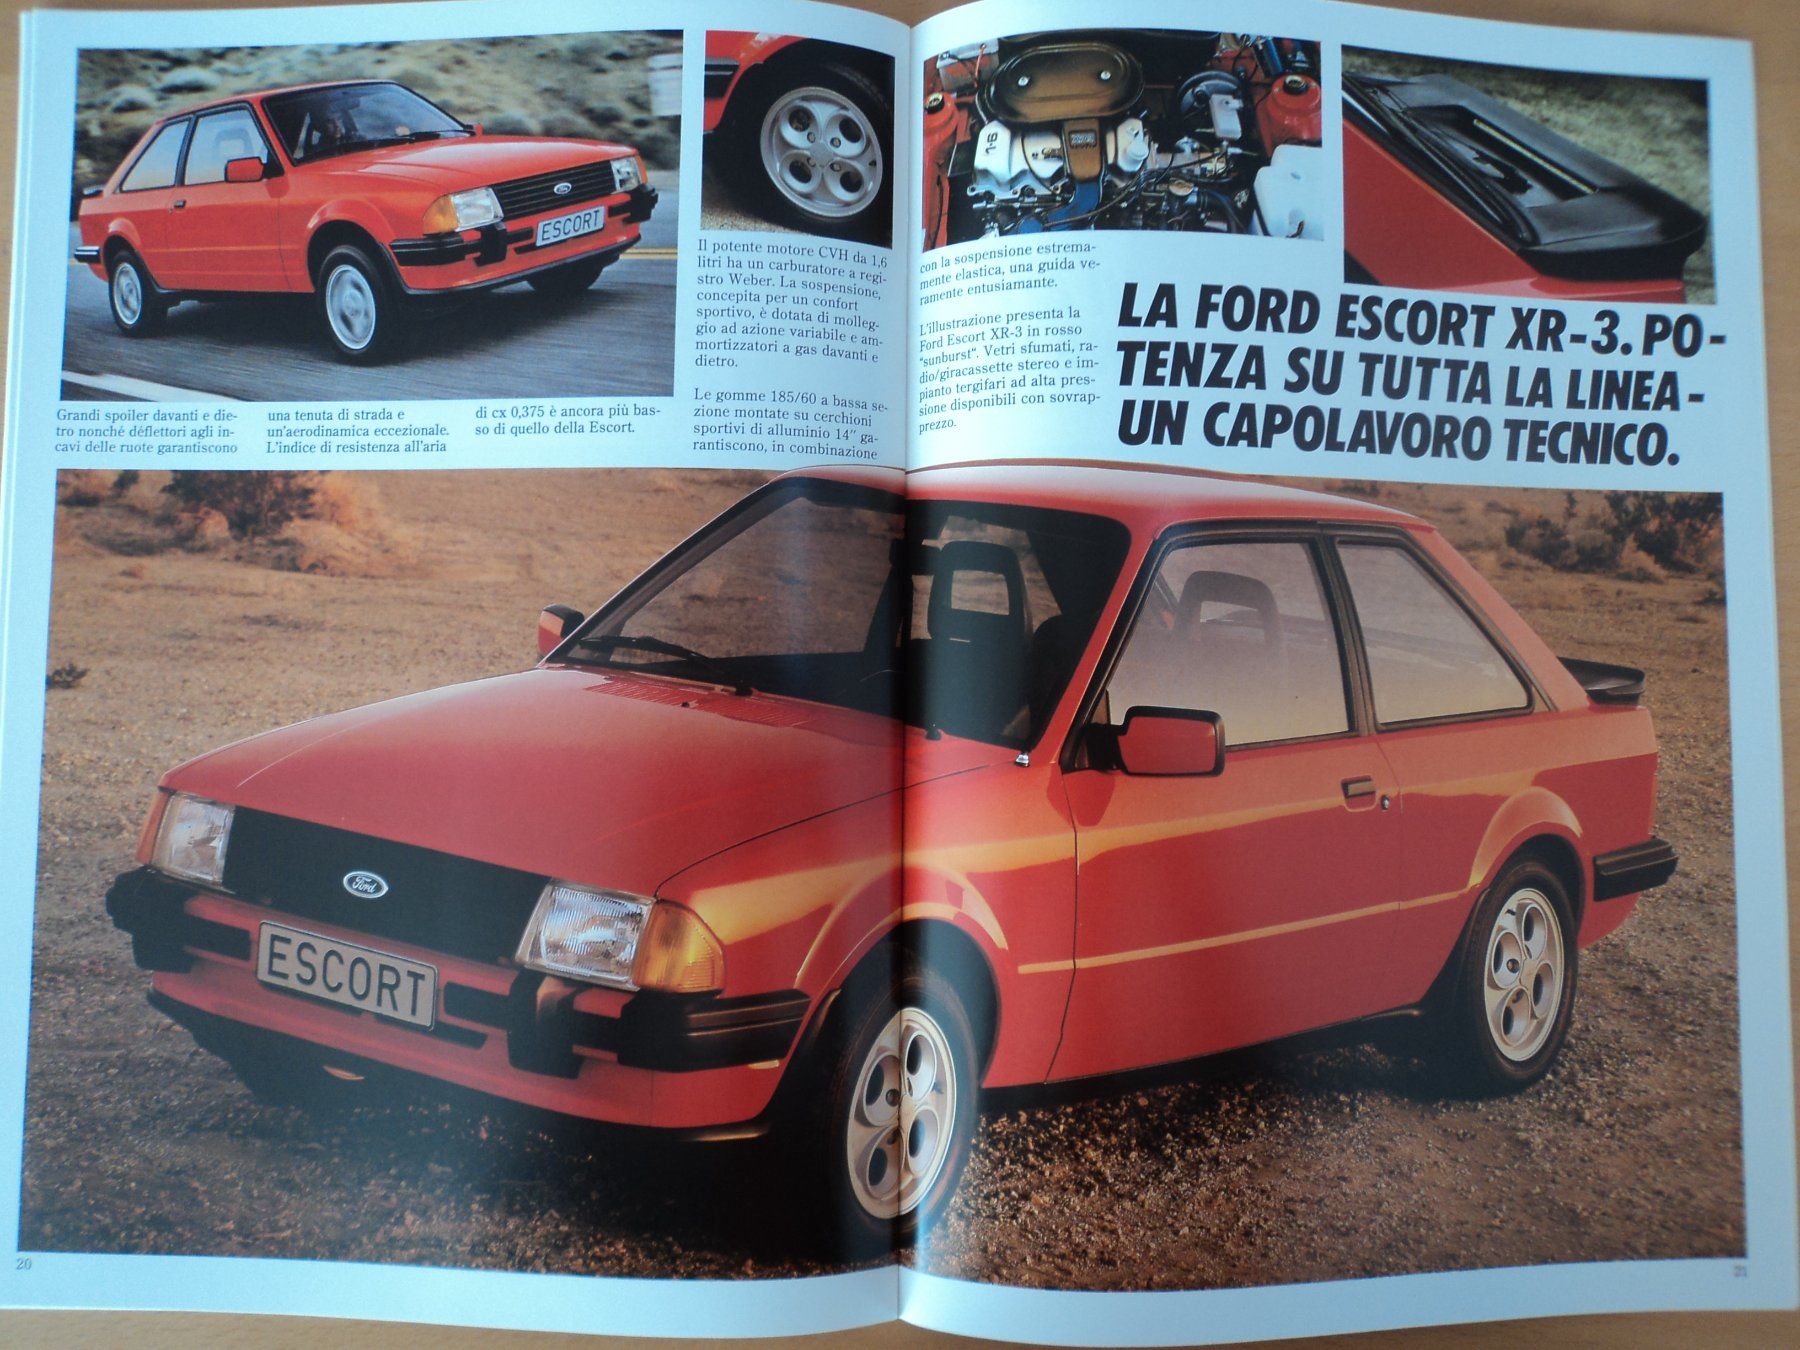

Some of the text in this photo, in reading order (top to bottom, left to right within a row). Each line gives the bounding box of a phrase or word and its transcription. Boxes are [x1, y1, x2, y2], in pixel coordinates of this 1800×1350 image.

[542, 210, 599, 241] ESCORT
[698, 239, 887, 269] Il potente motore CVH da 1,6
[920, 242, 1096, 273] con la sospensione estrema-
[698, 256, 886, 285] litri ha un carburatore a regi-
[920, 258, 1100, 290] mente elastica, una guida ve-
[697, 273, 881, 300] stro Weber. La sospensione,
[920, 276, 1058, 305] ramente entusiamante.
[697, 290, 858, 311] concepita per un confort
[696, 307, 880, 332] sportivo, è dotata di molleg-
[1006, 307, 1063, 323] presenta
[1069, 306, 1080, 318] la
[1118, 283, 1178, 328] LA
[1196, 284, 1320, 334] FORD
[1335, 294, 1495, 349] ESCORT
[1505, 306, 1632, 355] XR-3.
[696, 323, 883, 346] gio ad azione variabile e am-
[920, 325, 1082, 352] Ford Escort XR-3 in rosso
[696, 339, 878, 363] mortizzatori a gas davanti e
[984, 343, 1015, 357] Vetri
[1021, 340, 1074, 353] sfumati,
[1080, 342, 1098, 351] ra-
[695, 355, 738, 367] dietro.
[920, 356, 1099, 384] dio/giracassette stereo e im-
[1117, 341, 1267, 391] TENZA
[1284, 348, 1344, 396] SU
[1359, 352, 1492, 404] TUTTA
[1504, 365, 1553, 408] LA
[920, 374, 1095, 402] pianto tergifari ad alta pres-
[476, 403, 661, 420] di cx 0,375 è ancora più bas-
[695, 388, 888, 412] Le gomme 185/60 a bassa se-
[920, 392, 1100, 416] sione disponibili con sovrap-
[57, 409, 237, 425] Grandi spoiler davanti e die-
[268, 408, 405, 421] una tenuta di strada e
[694, 405, 872, 426] zione montate su cerchioni
[56, 427, 74, 436] tro
[79, 425, 124, 437] nonché
[191, 426, 213, 439] agli
[218, 426, 234, 437] in-
[267, 424, 449, 437] un'aerodinamica eccezionale.
[476, 421, 634, 437] so di quello della Escort.
[694, 423, 744, 436] sportivi
[751, 423, 762, 434] di
[767, 425, 830, 439] alluminio
[860, 433, 878, 444] ga-
[919, 419, 956, 434] prezzo.
[1118, 399, 1680, 465] UN CAPOLAVORO TECNICO.
[55, 441, 237, 455] cavi delle ruote garantiscono
[266, 441, 446, 453] L'indice di resistenza all'aria
[693, 439, 877, 460] rantiscono, in combinazione
[353, 876, 377, 893] Ford
[268, 934, 425, 1016] ESCORT
[17, 1258, 32, 1270] 20
